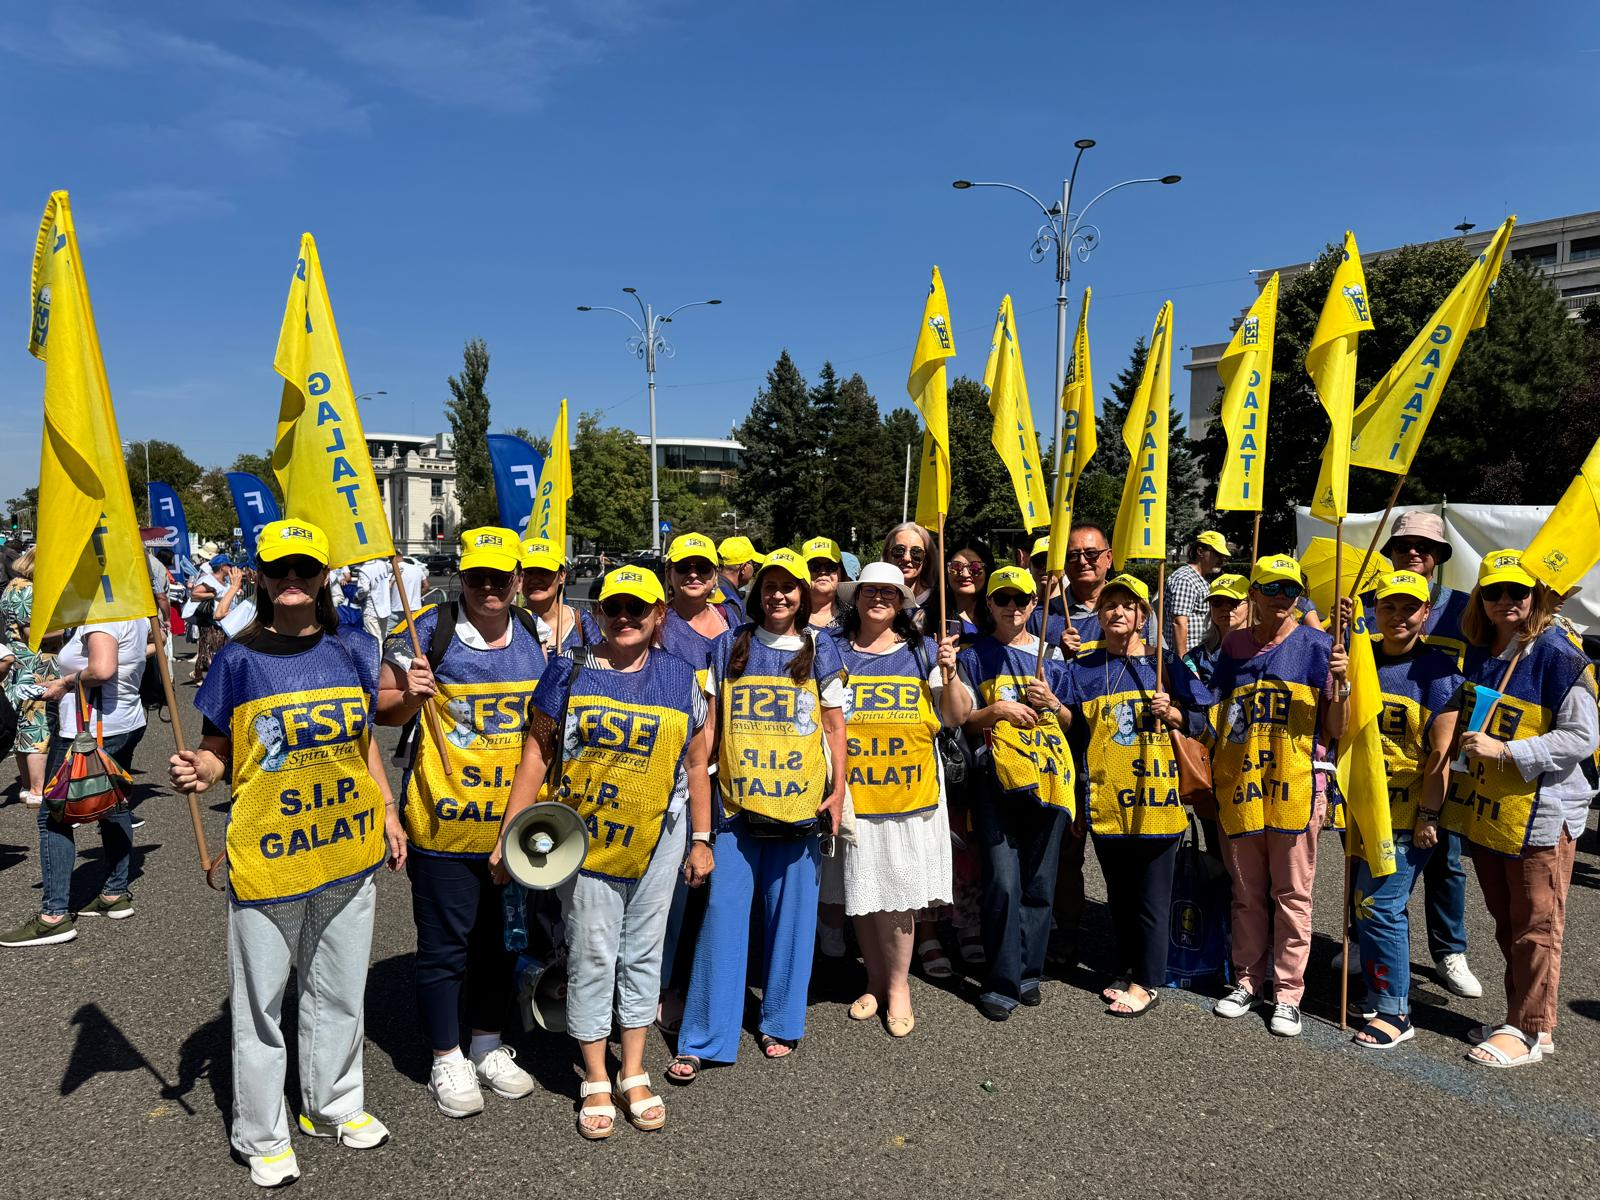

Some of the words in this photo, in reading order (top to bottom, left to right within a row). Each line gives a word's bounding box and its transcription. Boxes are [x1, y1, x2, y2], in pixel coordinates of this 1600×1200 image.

[1354, 294, 1369, 320] FSE
[938, 324, 950, 348] FSE
[1246, 323, 1257, 344] FSE
[290, 527, 312, 539] FSE
[482, 535, 502, 545] FSE
[623, 572, 642, 582] FSE
[855, 684, 917, 708] FSE
[282, 702, 362, 746] FSE
[474, 696, 531, 731] FS
[854, 711, 885, 723] Spiru
[887, 710, 919, 720] Haret
[476, 734, 512, 748] Spiru
[579, 709, 656, 752] FSE
[289, 751, 329, 766] Spiru
[846, 737, 908, 757] S.I.P.
[608, 752, 648, 768] Haret
[1132, 758, 1178, 778] S.I.P
[461, 764, 518, 788] S.I.
[846, 764, 921, 791] ALAȚI
[280, 777, 359, 816] S.I.P.
[434, 797, 502, 822] GAL
[259, 808, 375, 860] GALAȚI
[585, 814, 635, 849] AȚI
